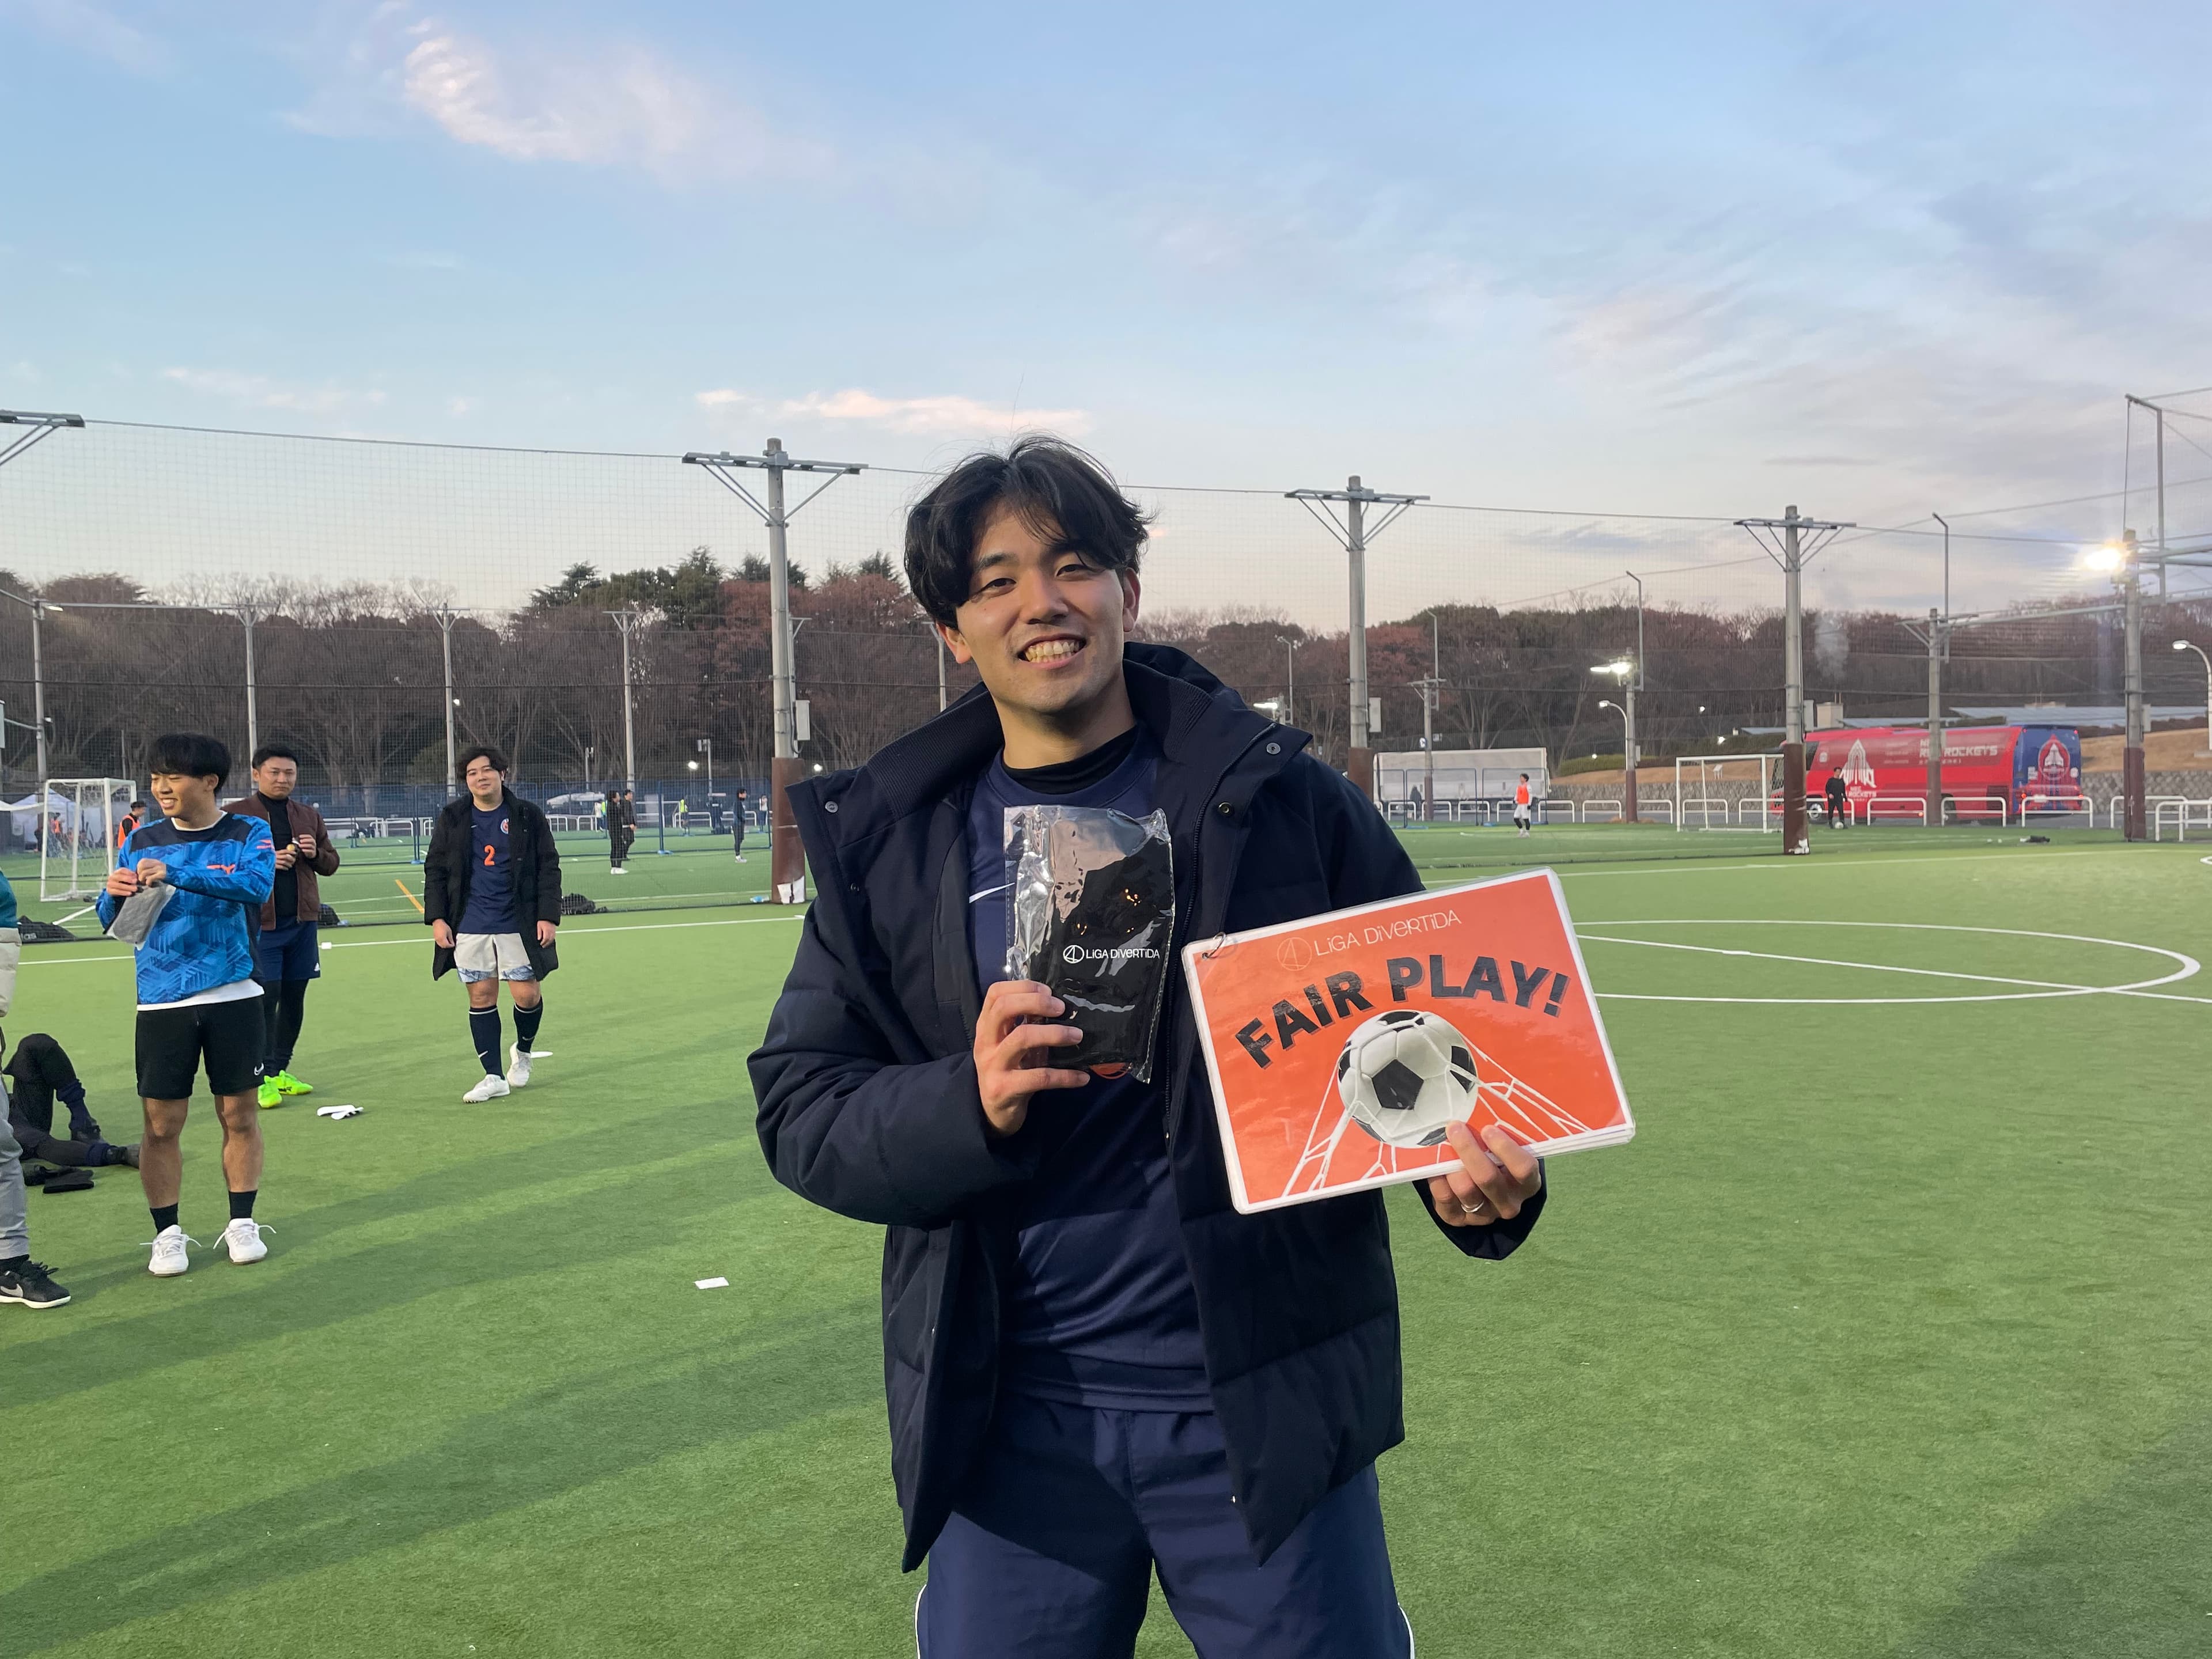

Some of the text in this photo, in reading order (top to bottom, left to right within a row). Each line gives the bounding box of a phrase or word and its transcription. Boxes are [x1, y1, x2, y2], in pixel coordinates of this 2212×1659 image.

[1944, 745, 1998, 757] ROCKETS
[484, 844, 495, 866] 2
[1235, 954, 1570, 1069] FAIR PLAY!
